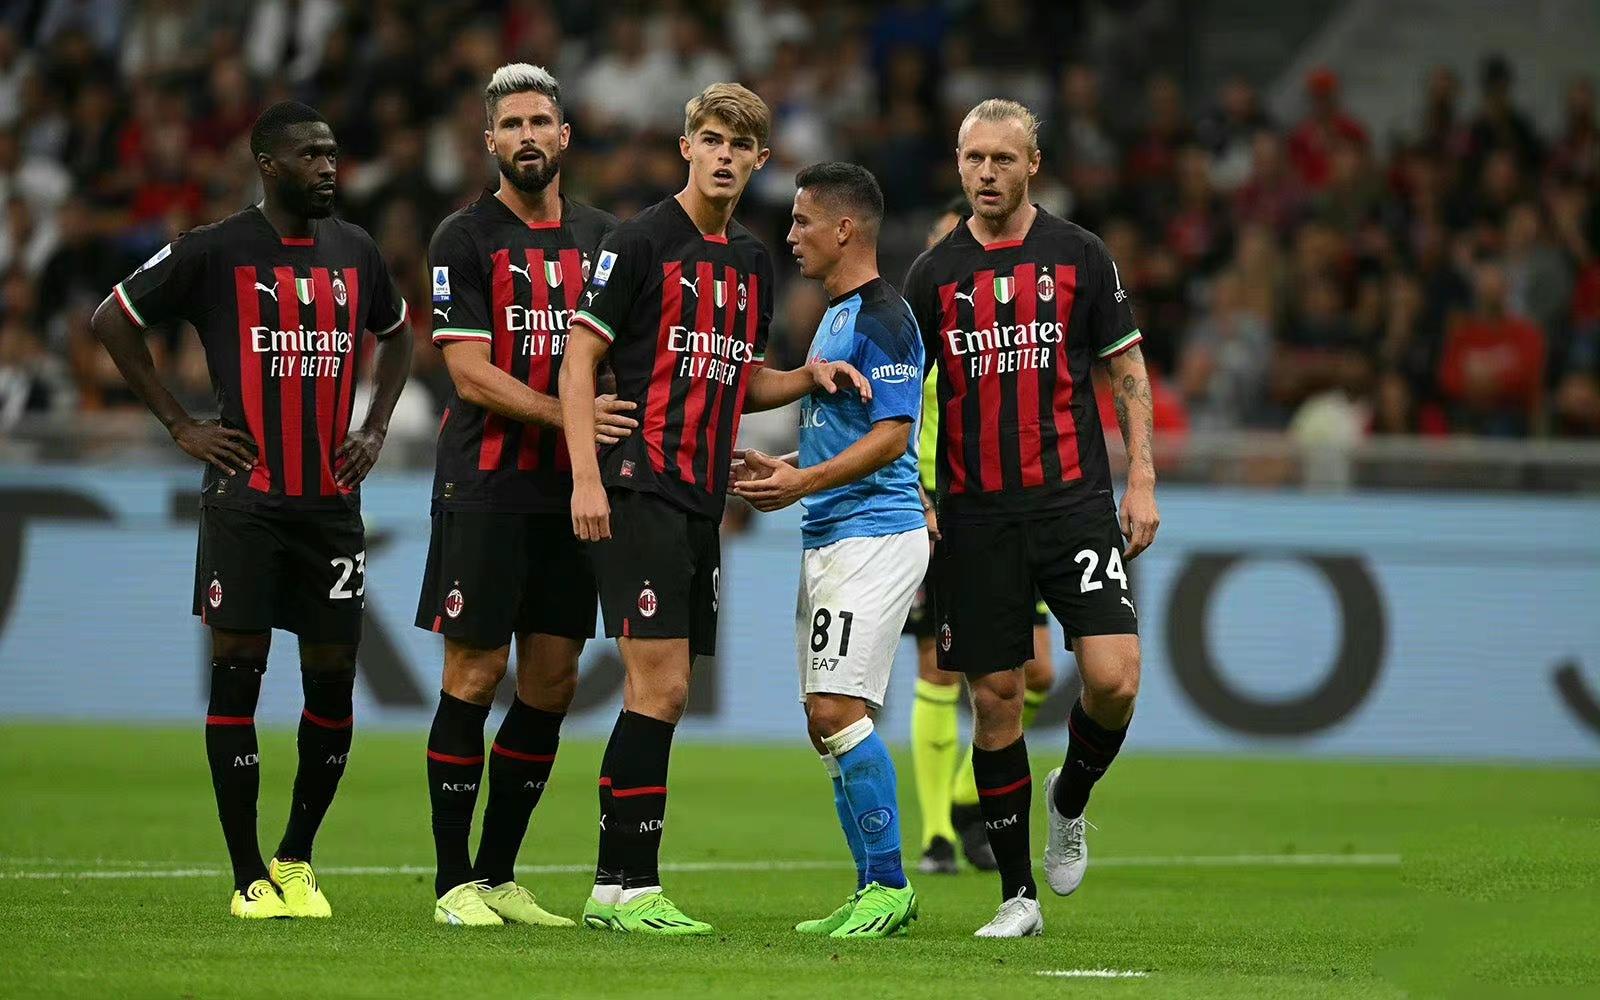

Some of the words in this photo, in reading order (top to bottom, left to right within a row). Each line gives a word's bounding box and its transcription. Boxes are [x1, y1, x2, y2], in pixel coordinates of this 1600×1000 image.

[504, 304, 576, 332] Emira
[250, 324, 353, 354] Emirates
[521, 334, 546, 356] FLY
[946, 319, 1064, 356] Emirates
[270, 355, 297, 377] FLY
[679, 356, 707, 378] FLY
[970, 353, 993, 378] FLY
[996, 347, 1051, 374] BETTER
[329, 550, 366, 599] 23
[1073, 546, 1129, 594] 24
[810, 607, 854, 657] 81
[812, 657, 840, 671] EA7
[442, 782, 477, 792] ACM
[984, 813, 1018, 830] ACM
